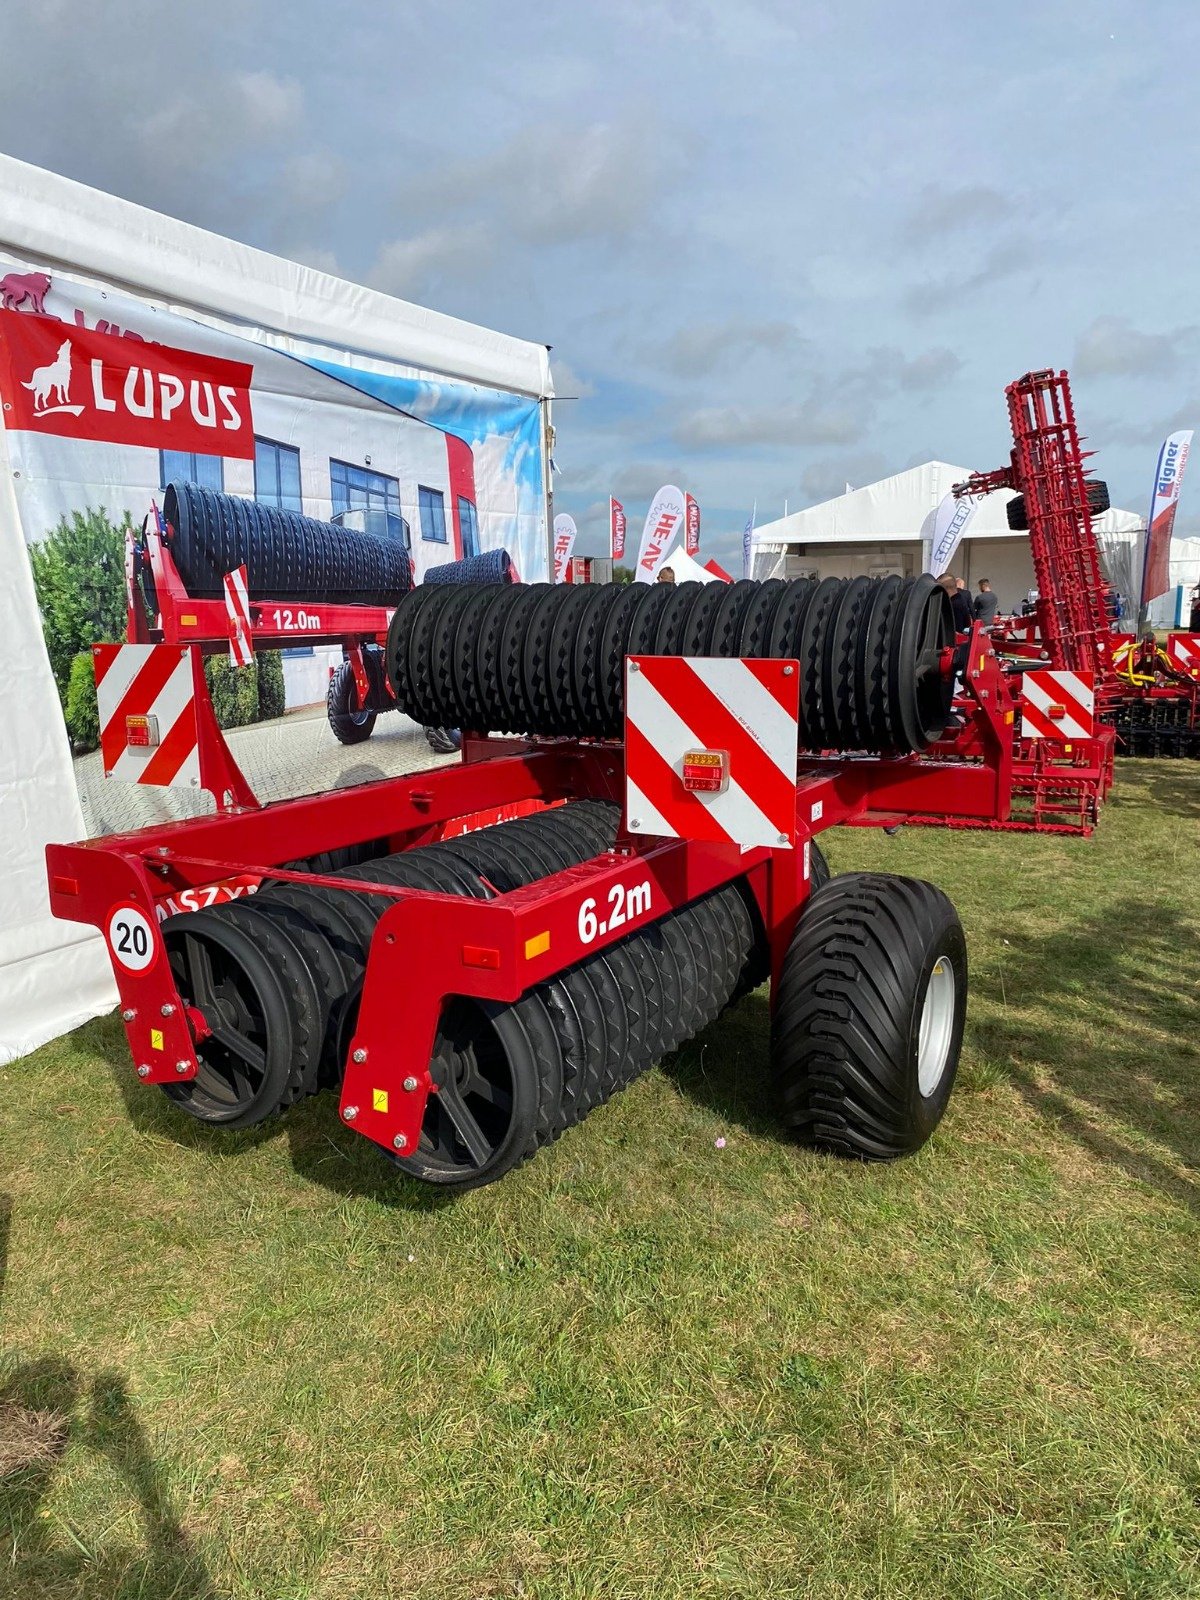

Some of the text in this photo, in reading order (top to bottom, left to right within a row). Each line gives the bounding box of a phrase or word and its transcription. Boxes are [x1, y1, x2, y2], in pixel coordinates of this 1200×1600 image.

[91, 359, 242, 431] LUPUS
[934, 504, 971, 564] SAUTER
[273, 610, 321, 630] 12.0m
[116, 922, 147, 957] 20
[578, 880, 651, 944] 6.2m
